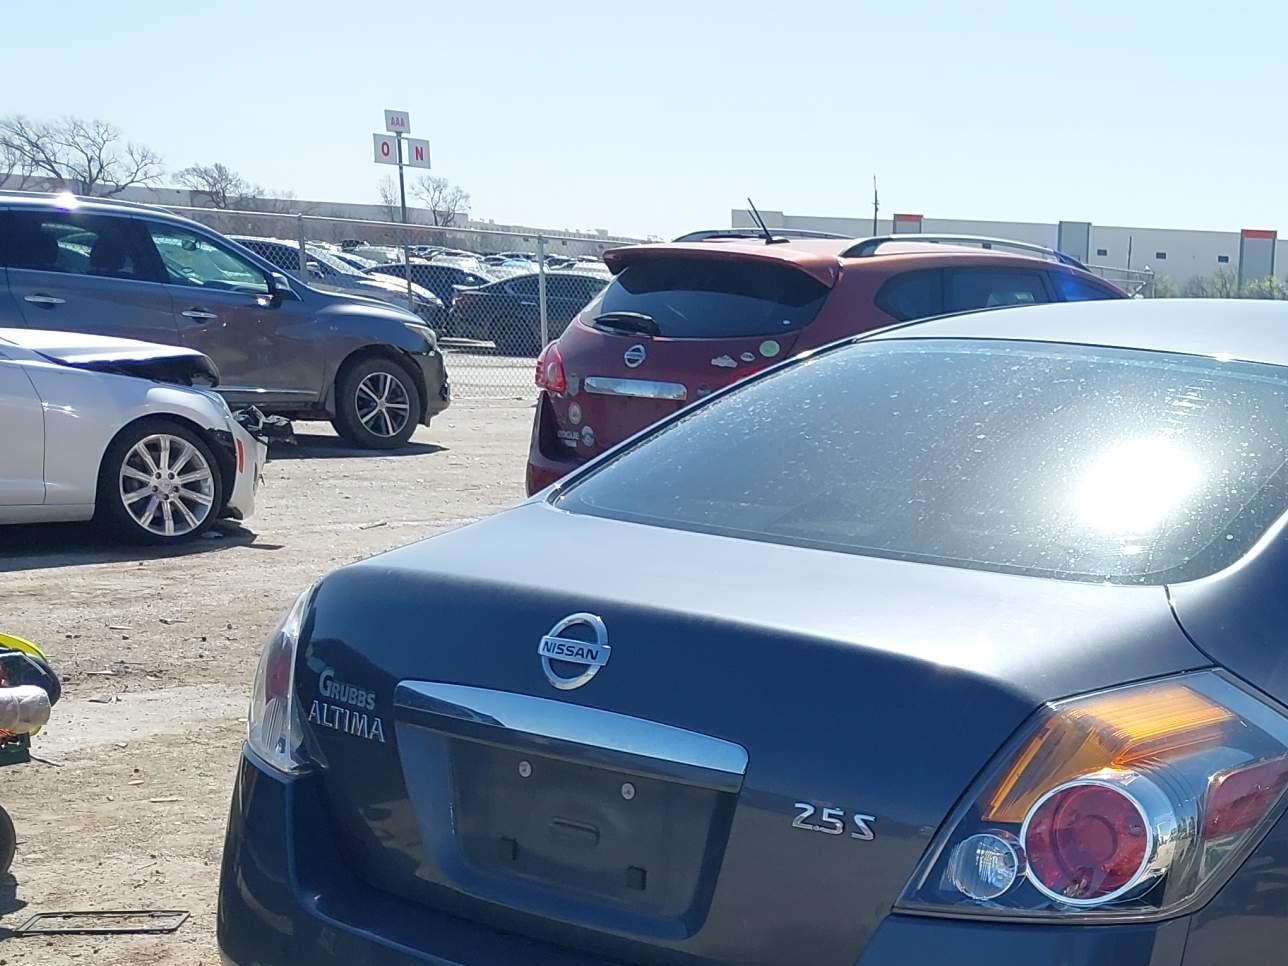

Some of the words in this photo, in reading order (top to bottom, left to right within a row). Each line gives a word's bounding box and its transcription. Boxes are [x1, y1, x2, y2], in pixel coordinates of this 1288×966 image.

[415, 146, 424, 161] N
[542, 640, 599, 661] NISSAN
[308, 699, 386, 744] ALTIMA
[850, 813, 877, 841] S
